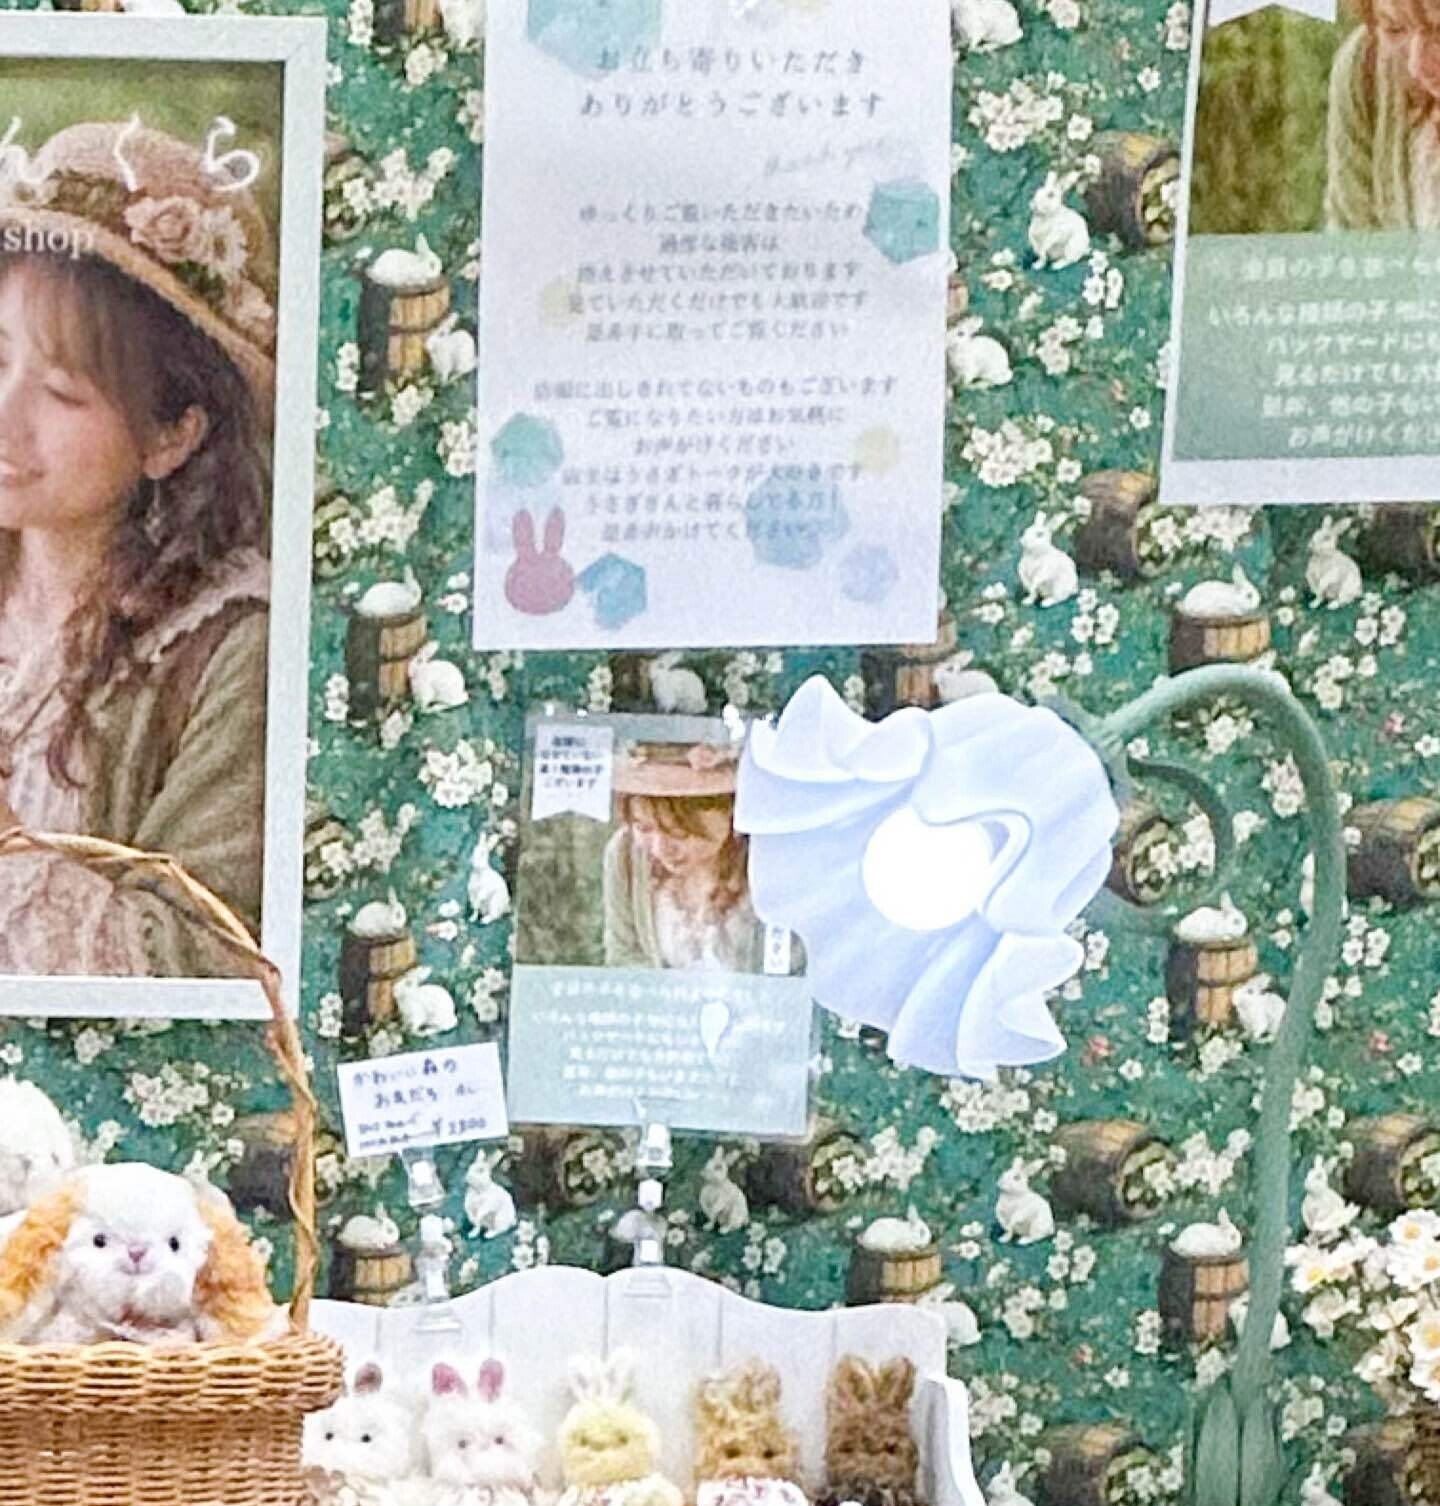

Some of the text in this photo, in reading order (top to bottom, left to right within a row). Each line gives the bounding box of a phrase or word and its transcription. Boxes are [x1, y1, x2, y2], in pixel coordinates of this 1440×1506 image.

[596, 46, 865, 76] お立ち寄りいただき
[580, 90, 885, 120] ありがとうございます
[3, 214, 95, 261] shop
